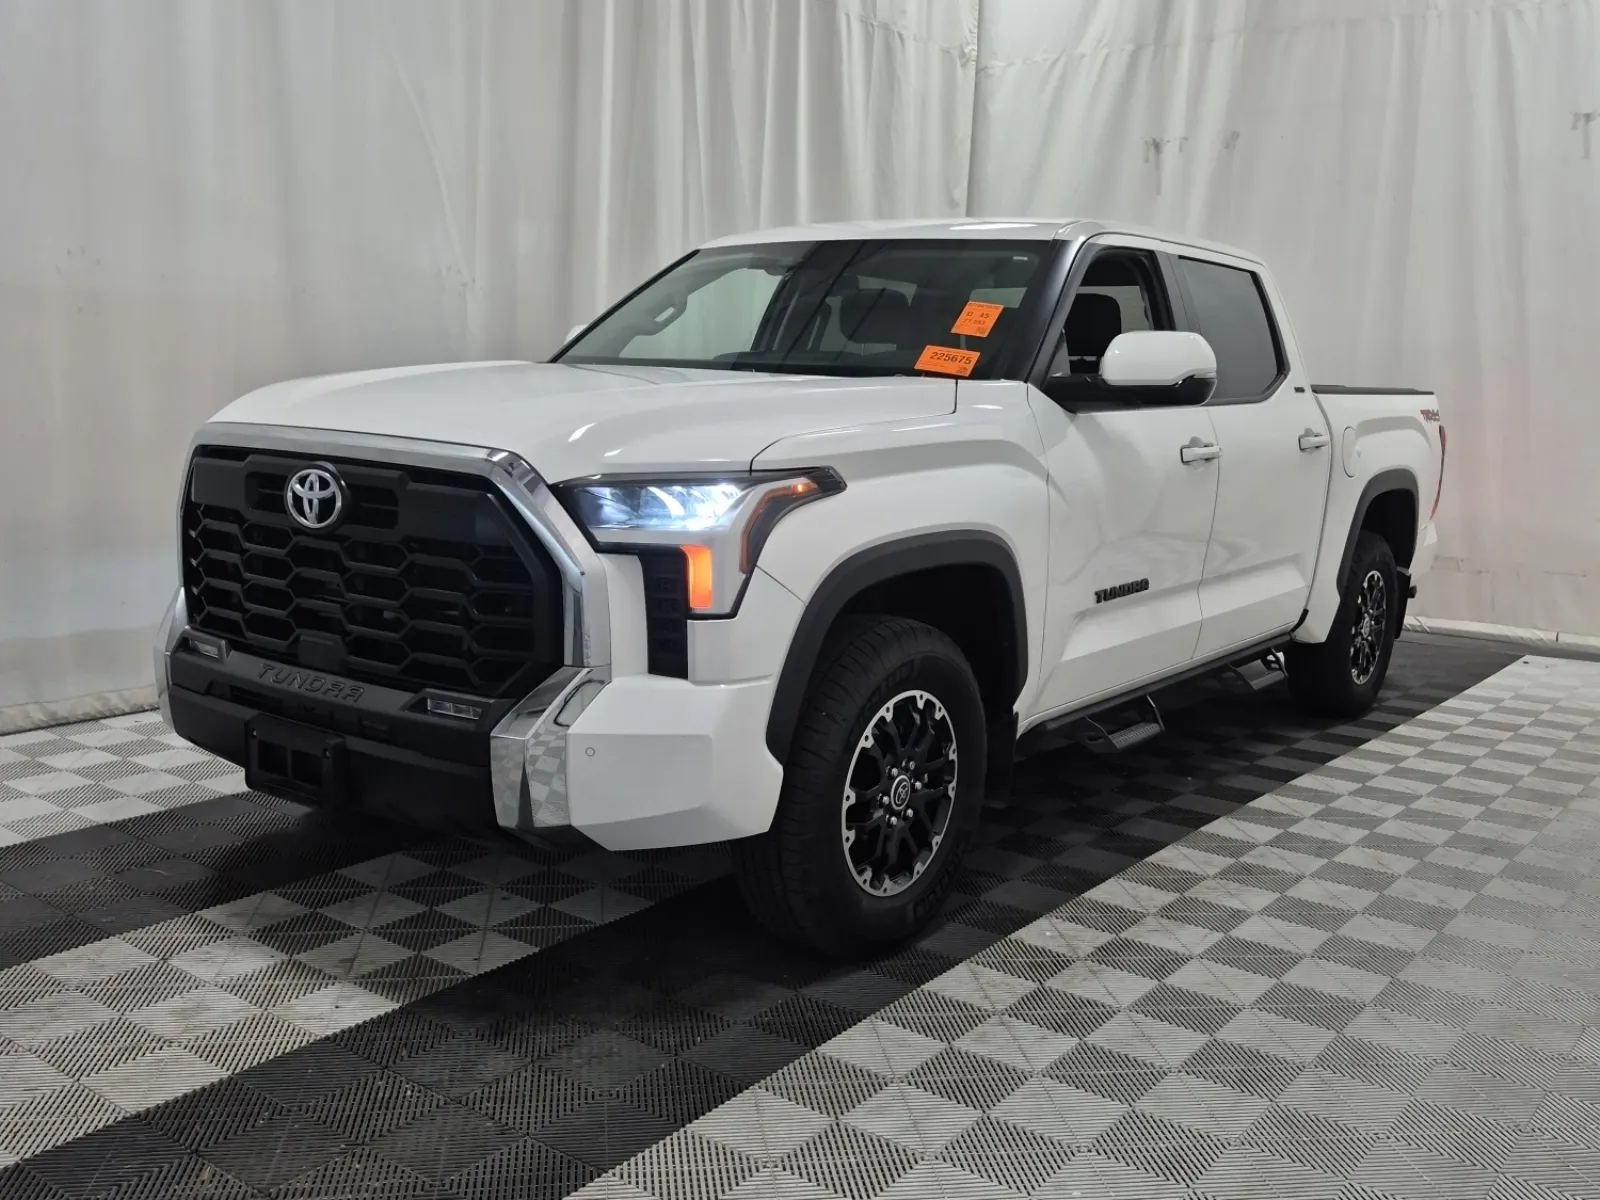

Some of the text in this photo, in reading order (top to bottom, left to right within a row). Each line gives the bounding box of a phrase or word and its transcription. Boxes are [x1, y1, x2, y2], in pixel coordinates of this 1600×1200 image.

[930, 352, 972, 365] 225675
[1094, 578, 1149, 604] TUNDRA
[258, 663, 365, 702] TUNDRA
